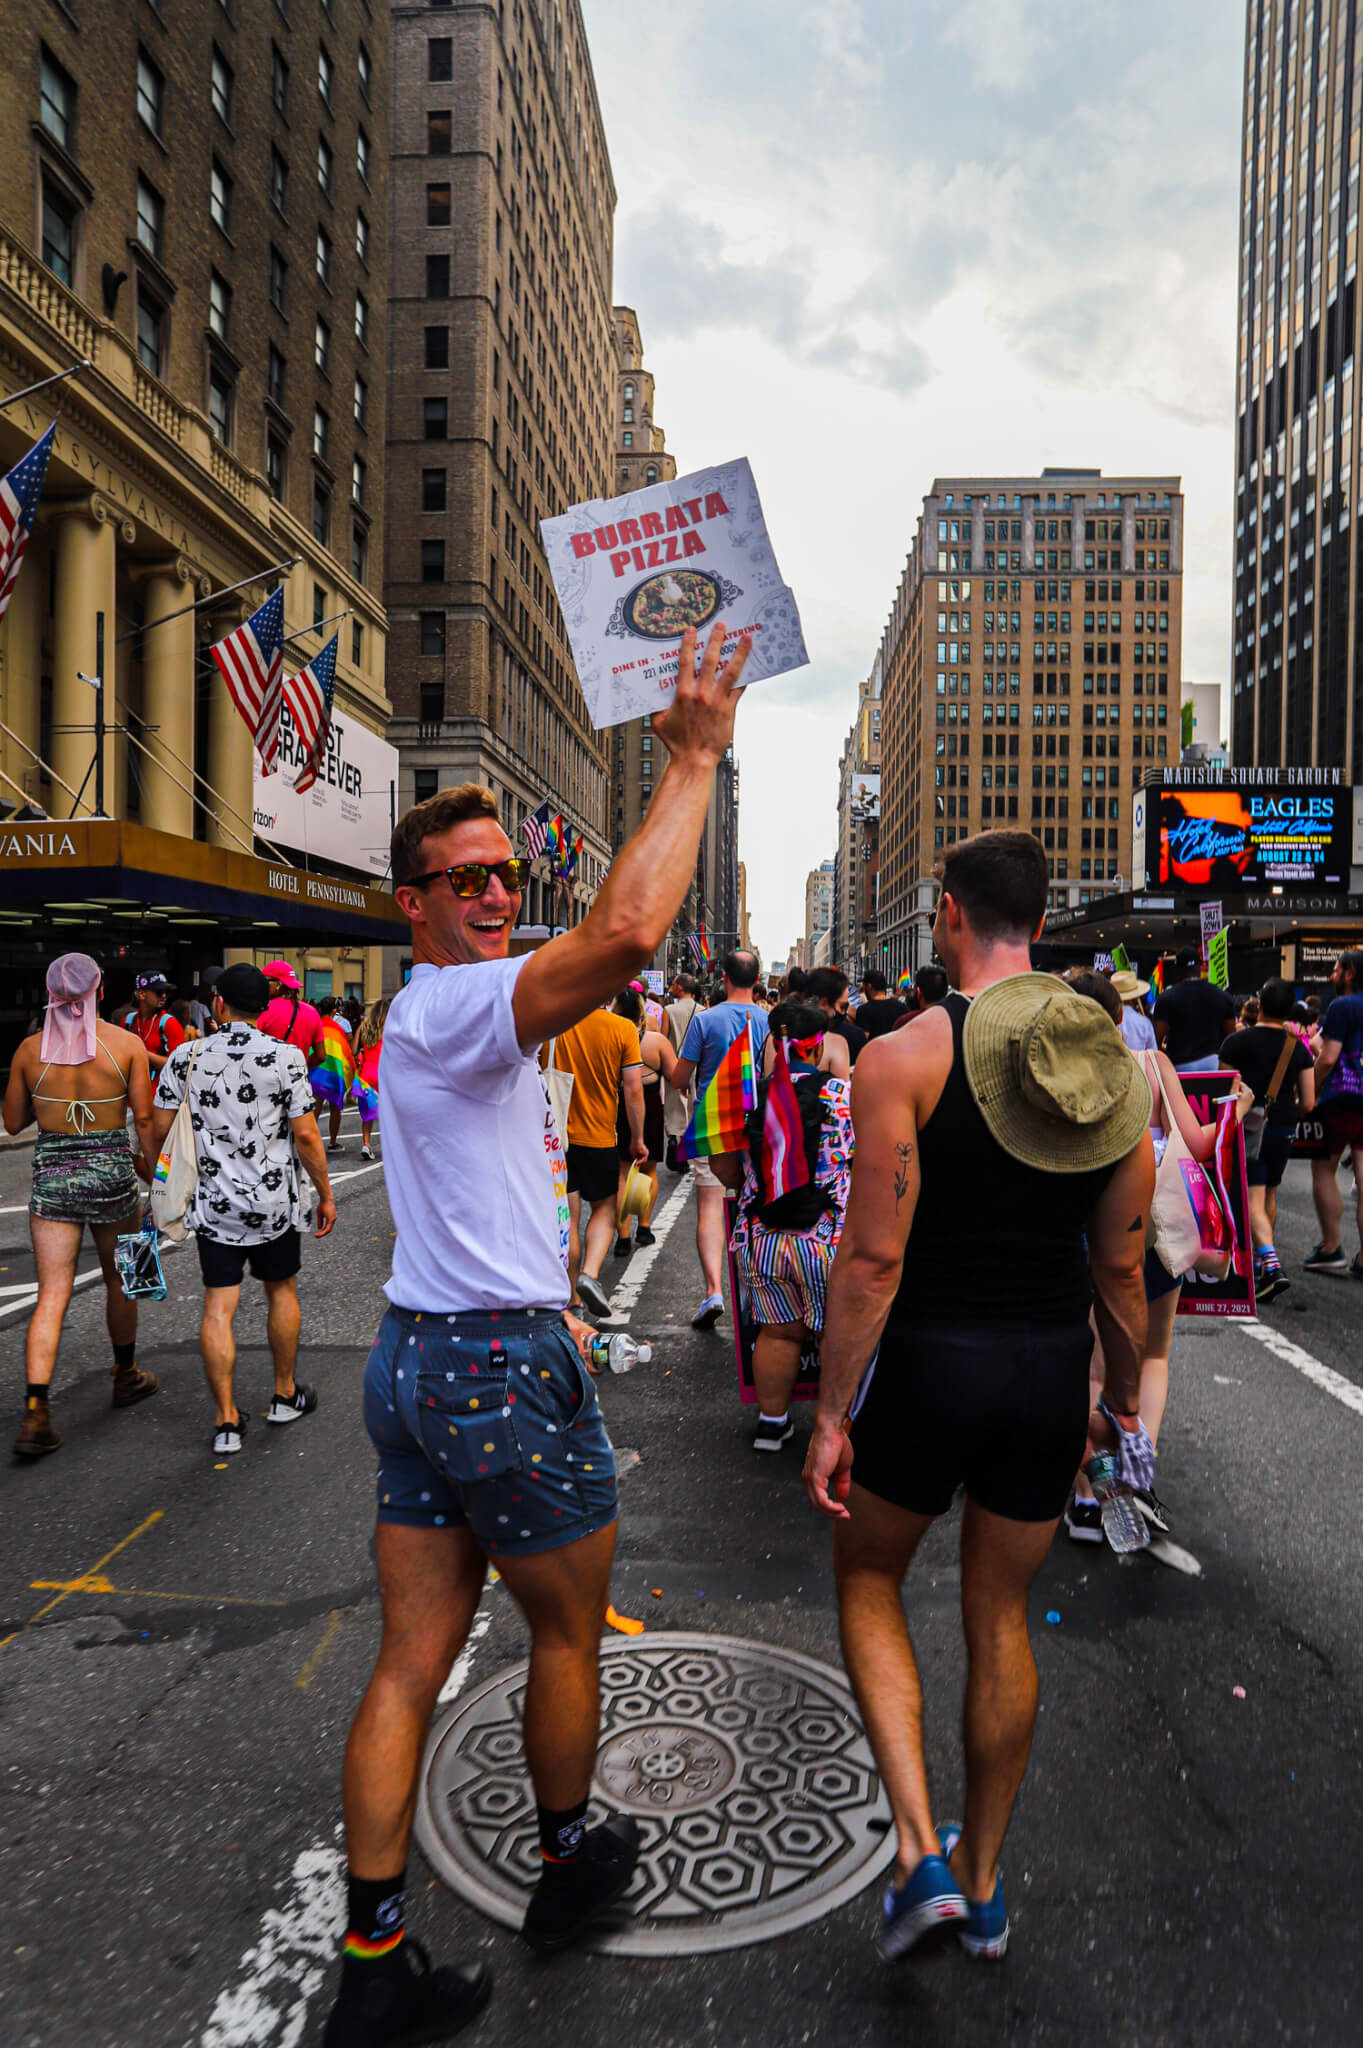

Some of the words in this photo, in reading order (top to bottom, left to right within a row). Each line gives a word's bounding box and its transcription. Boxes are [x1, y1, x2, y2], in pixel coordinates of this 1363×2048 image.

[571, 492, 730, 559] BURRATA
[609, 530, 707, 578] PIZZA
[611, 663, 635, 675] DINE
[638, 659, 649, 668] IN
[722, 623, 763, 642] ATERING
[643, 668, 657, 680] 221
[659, 663, 679, 675] AVEN
[327, 753, 362, 799] EVER
[1163, 767, 1224, 785] MADISON
[1230, 767, 1280, 785] SQUARE
[1287, 767, 1341, 785] GARDEN
[1250, 797, 1334, 817] EAGLES
[1257, 850, 1290, 864] AUGUST
[268, 869, 300, 895] HOTEL
[306, 879, 366, 909] PENNSYLVANIA
[1247, 897, 1337, 910] MADISON
[1195, 1303, 1215, 1313] JUNE
[1217, 1303, 1230, 1313] 27,
[1231, 1304, 1251, 1313] 2021
